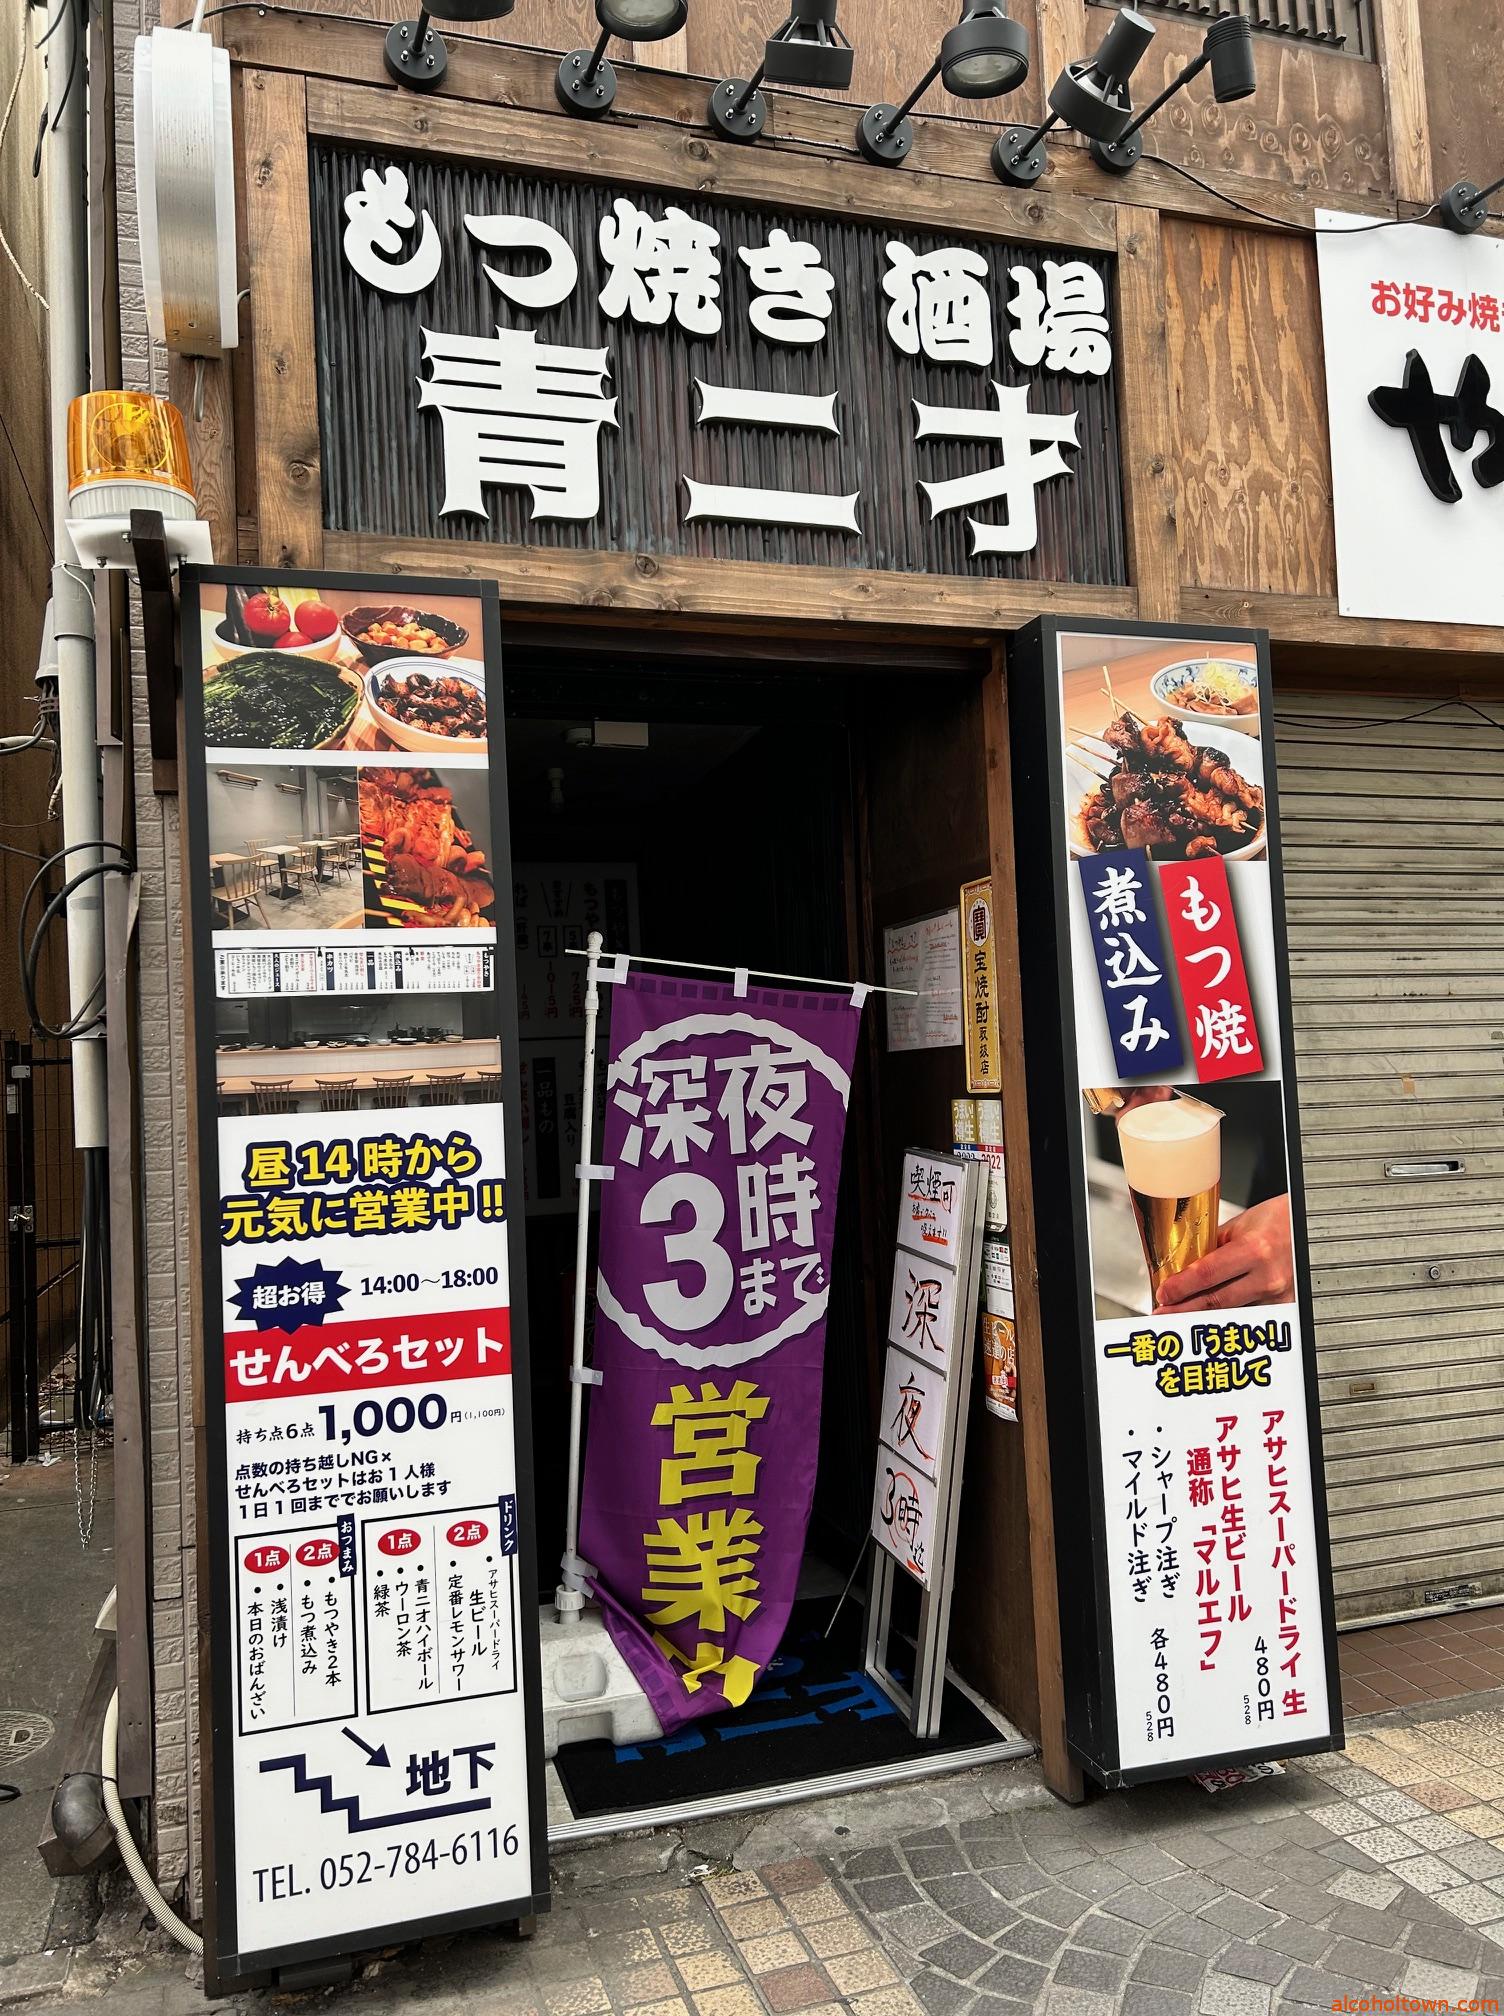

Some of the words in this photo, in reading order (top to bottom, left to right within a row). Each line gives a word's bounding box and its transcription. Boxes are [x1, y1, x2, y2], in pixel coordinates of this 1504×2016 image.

[342, 165, 835, 345] もつ焼き
[882, 239, 1113, 377] 酒場
[1370, 280, 1504, 333] お好み焼
[415, 324, 1082, 558] 青二才
[1092, 867, 1170, 1052] 煮込み
[1179, 875, 1254, 1060] もつ焼
[607, 1043, 815, 1167] 深夜
[246, 1134, 480, 1189] 昼14時から
[640, 1152, 823, 1332] 3時まで
[252, 1281, 326, 1310] 超お得
[229, 1326, 504, 1388] せんべろセット
[1157, 1358, 1272, 1397] を目指して
[236, 1422, 315, 1445] 持ち点6点
[387, 1533, 412, 1550] 1点
[453, 1524, 481, 1542] 2点
[503, 1500, 515, 1551] ドリンク
[1215, 1415, 1253, 1623] アサヒ生ビール
[254, 1550, 281, 1568] 1点
[303, 1543, 333, 1561] 2点
[341, 1521, 354, 1573] おつまみ
[469, 1589, 487, 1656] 生ビール
[1150, 1627, 1174, 1739] 各480円
[1254, 1635, 1275, 1723] 480円
[1145, 1710, 1154, 1743] 528
[1243, 1694, 1252, 1725] 528
[405, 1742, 496, 1797] 地下
[253, 1864, 311, 1903] TEL.
[320, 1824, 519, 1891] 052-784-6116
